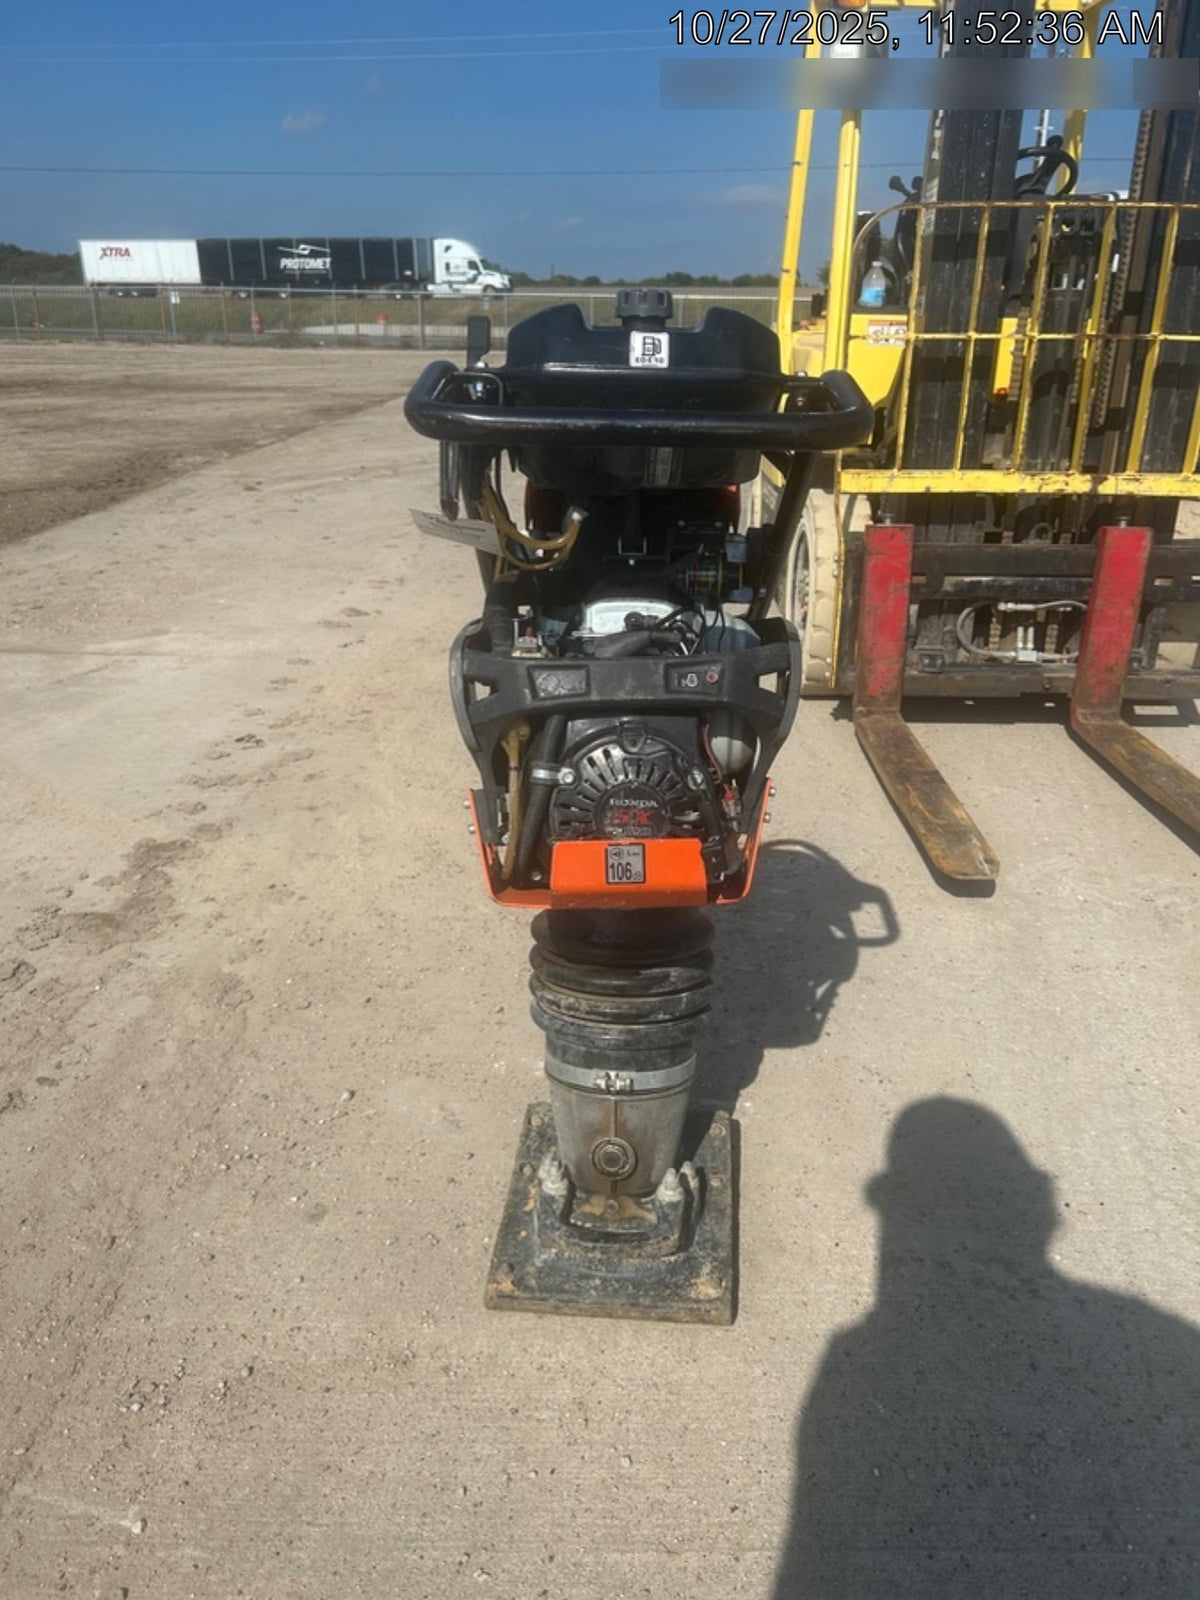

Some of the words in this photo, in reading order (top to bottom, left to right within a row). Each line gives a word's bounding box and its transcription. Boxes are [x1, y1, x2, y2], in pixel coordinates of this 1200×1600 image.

[99, 246, 131, 259] XTRA
[280, 257, 332, 269] PROTOMET
[609, 798, 659, 808] HONDA
[609, 862, 632, 881] 106
